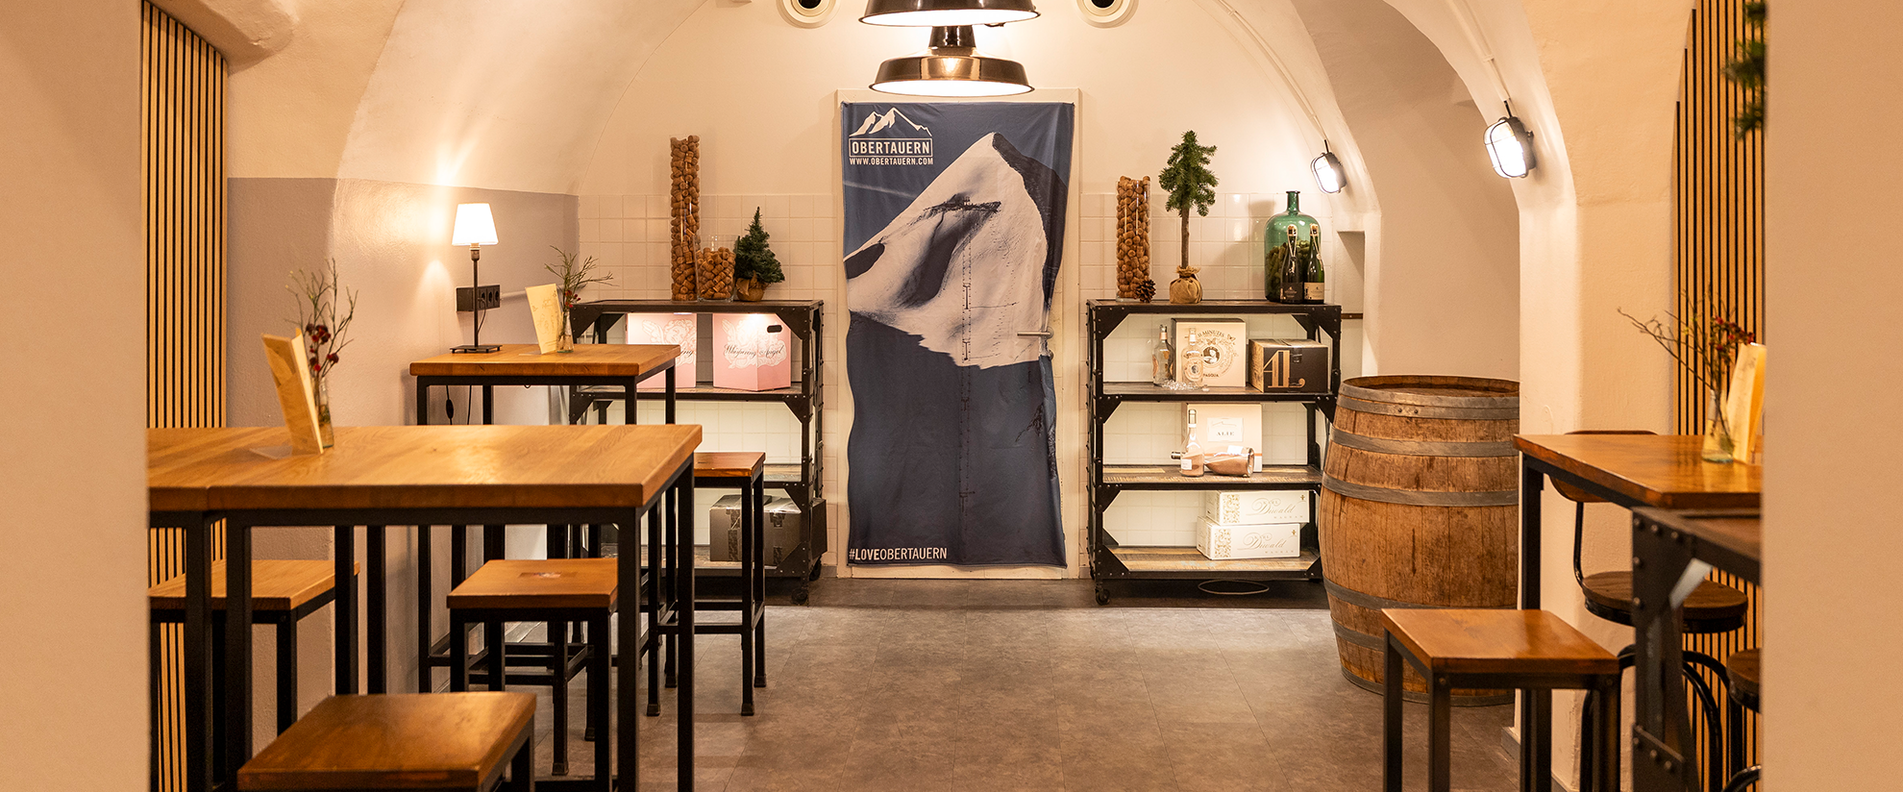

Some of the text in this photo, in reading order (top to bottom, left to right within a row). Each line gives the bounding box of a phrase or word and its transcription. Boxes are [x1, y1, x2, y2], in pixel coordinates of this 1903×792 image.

[852, 141, 930, 154] OBERTAUERN
[849, 157, 933, 165] WWW.OBERTAUERN.COM
[849, 548, 947, 560] #LOVEOBERTAUERN
